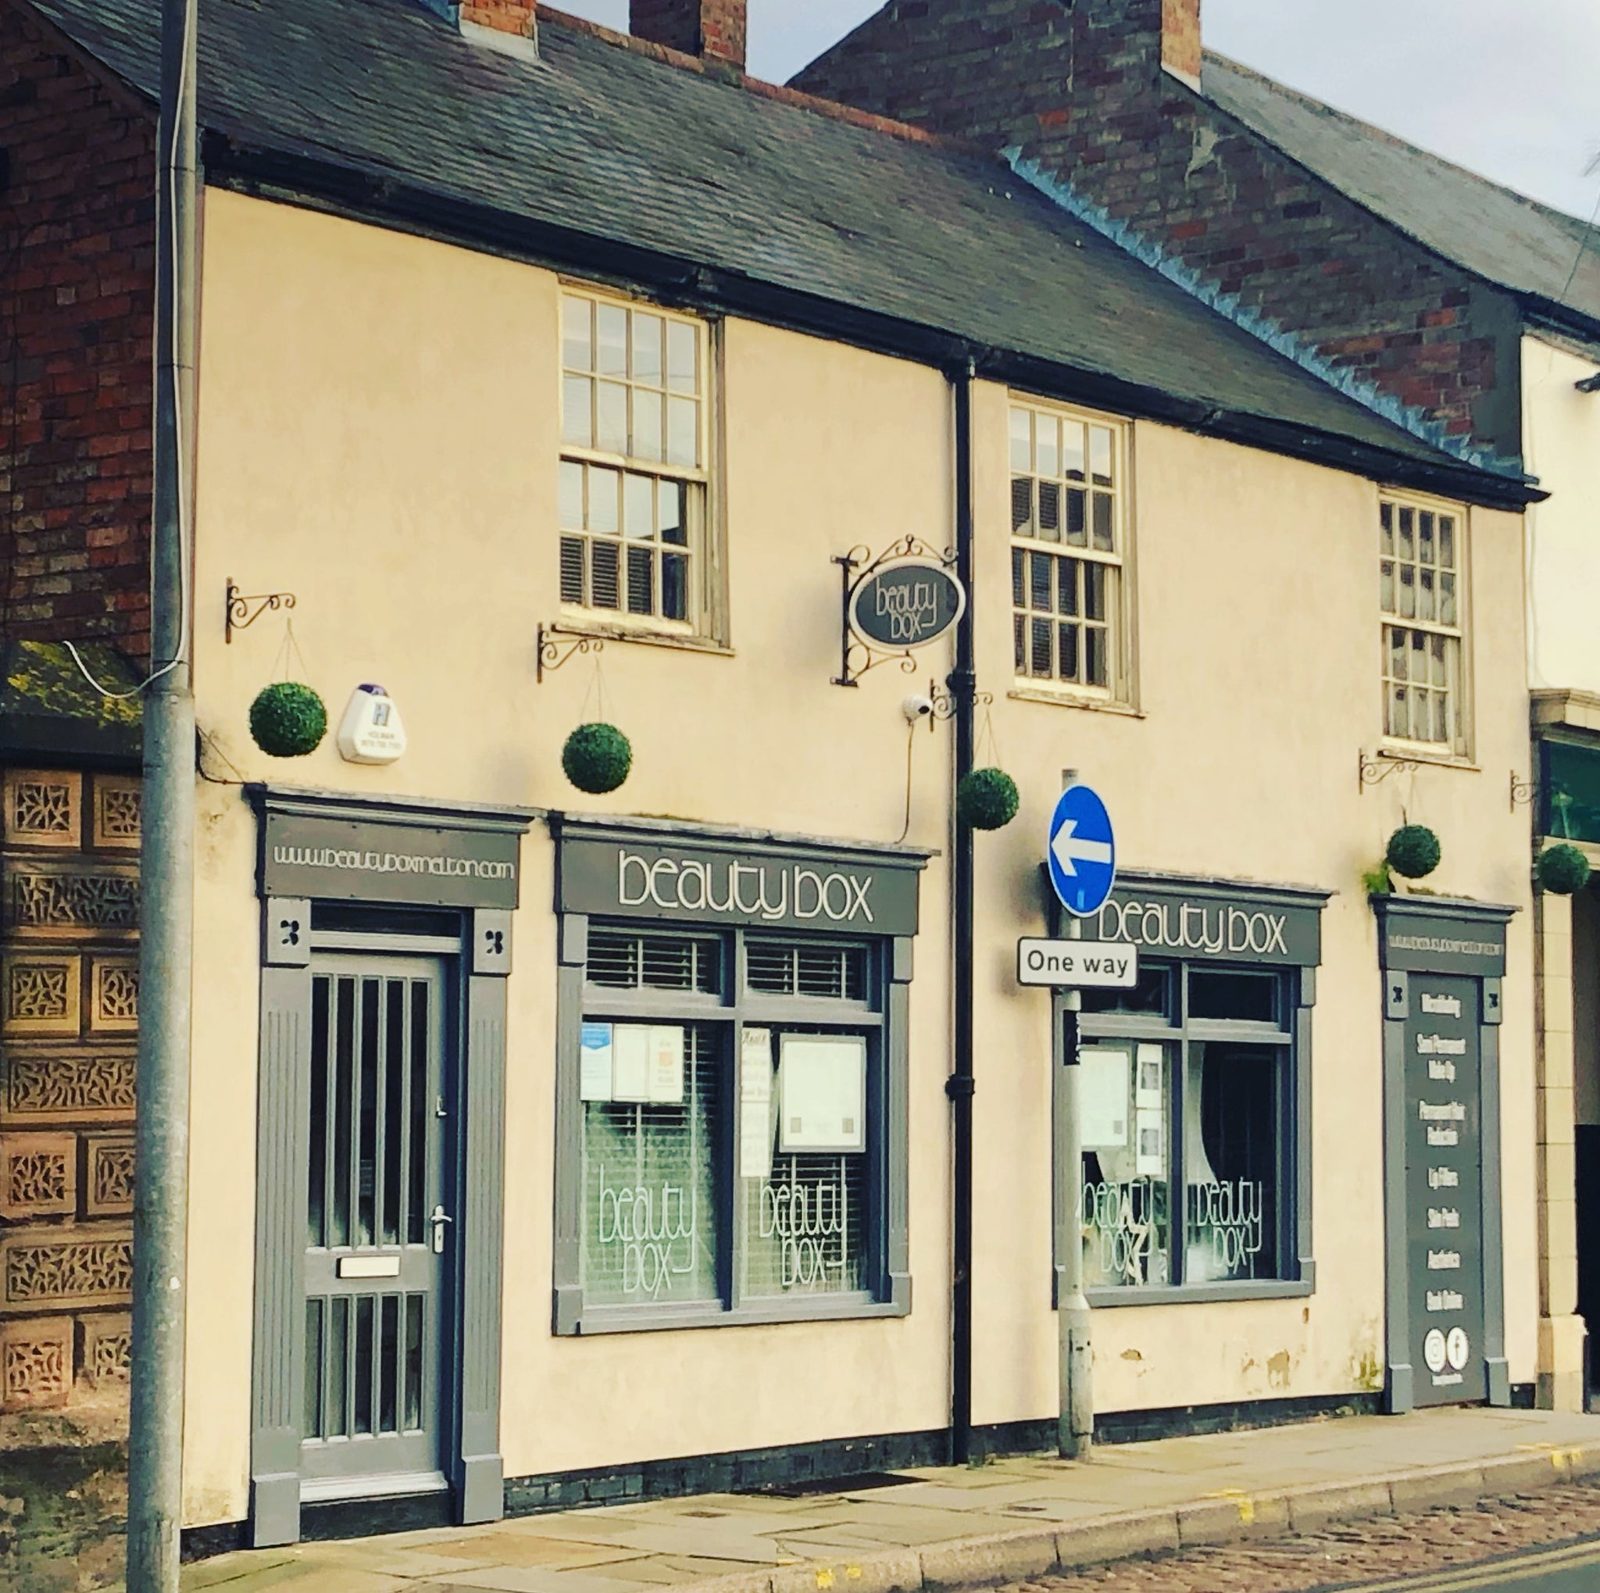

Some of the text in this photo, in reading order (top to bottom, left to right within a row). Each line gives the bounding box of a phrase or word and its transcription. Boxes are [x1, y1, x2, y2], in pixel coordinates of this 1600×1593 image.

[876, 576, 937, 627] beauty
[891, 611, 922, 641] box
[618, 849, 874, 922] beauty box
[1098, 899, 1288, 955] beauty box
[1028, 950, 1129, 979] One way
[600, 1162, 697, 1273] beauty
[759, 1176, 847, 1266] beauty
[1197, 1176, 1262, 1252] beauty
[624, 1242, 673, 1299] box
[782, 1238, 828, 1289] box
[1213, 1227, 1247, 1274] box
